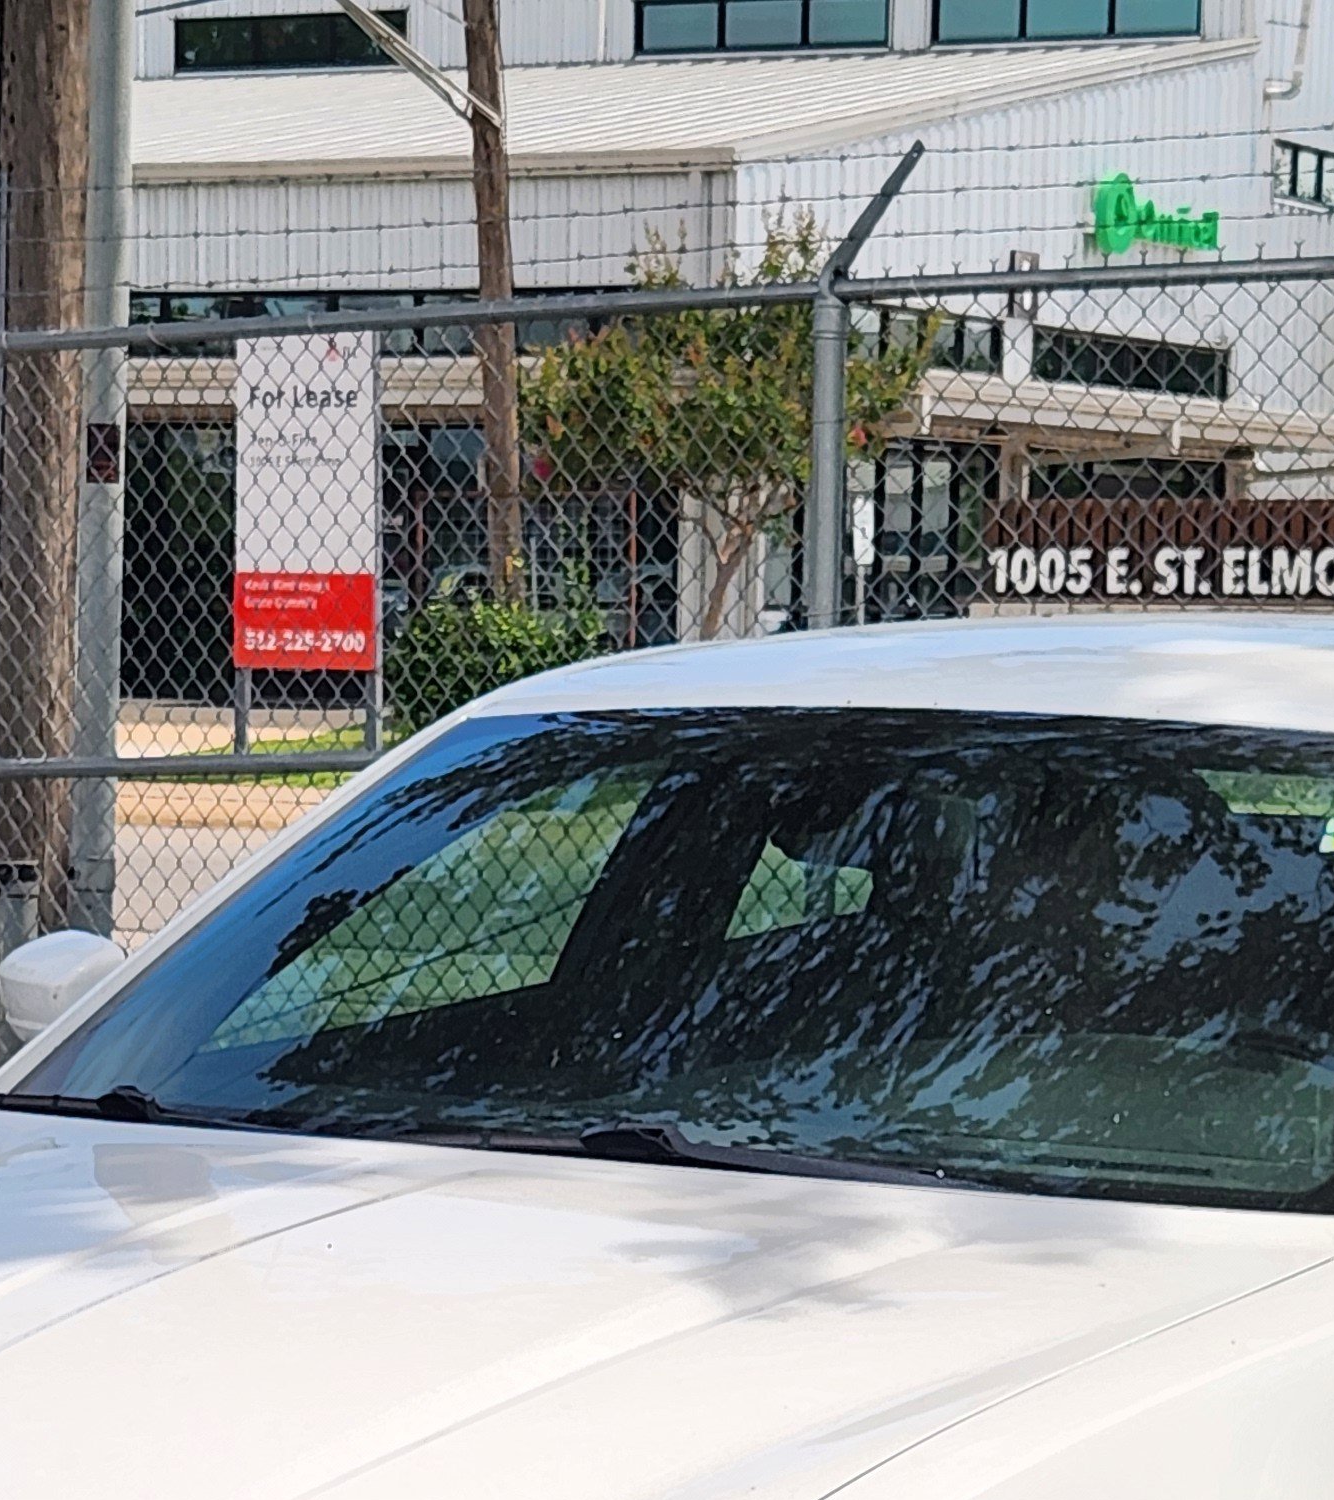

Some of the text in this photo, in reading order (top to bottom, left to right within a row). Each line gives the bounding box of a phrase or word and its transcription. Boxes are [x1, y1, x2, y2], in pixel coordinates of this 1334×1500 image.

[249, 384, 358, 409] For Lease
[988, 546, 1093, 595] 1005
[1106, 546, 1143, 595] E.
[1152, 546, 1212, 595] ST.
